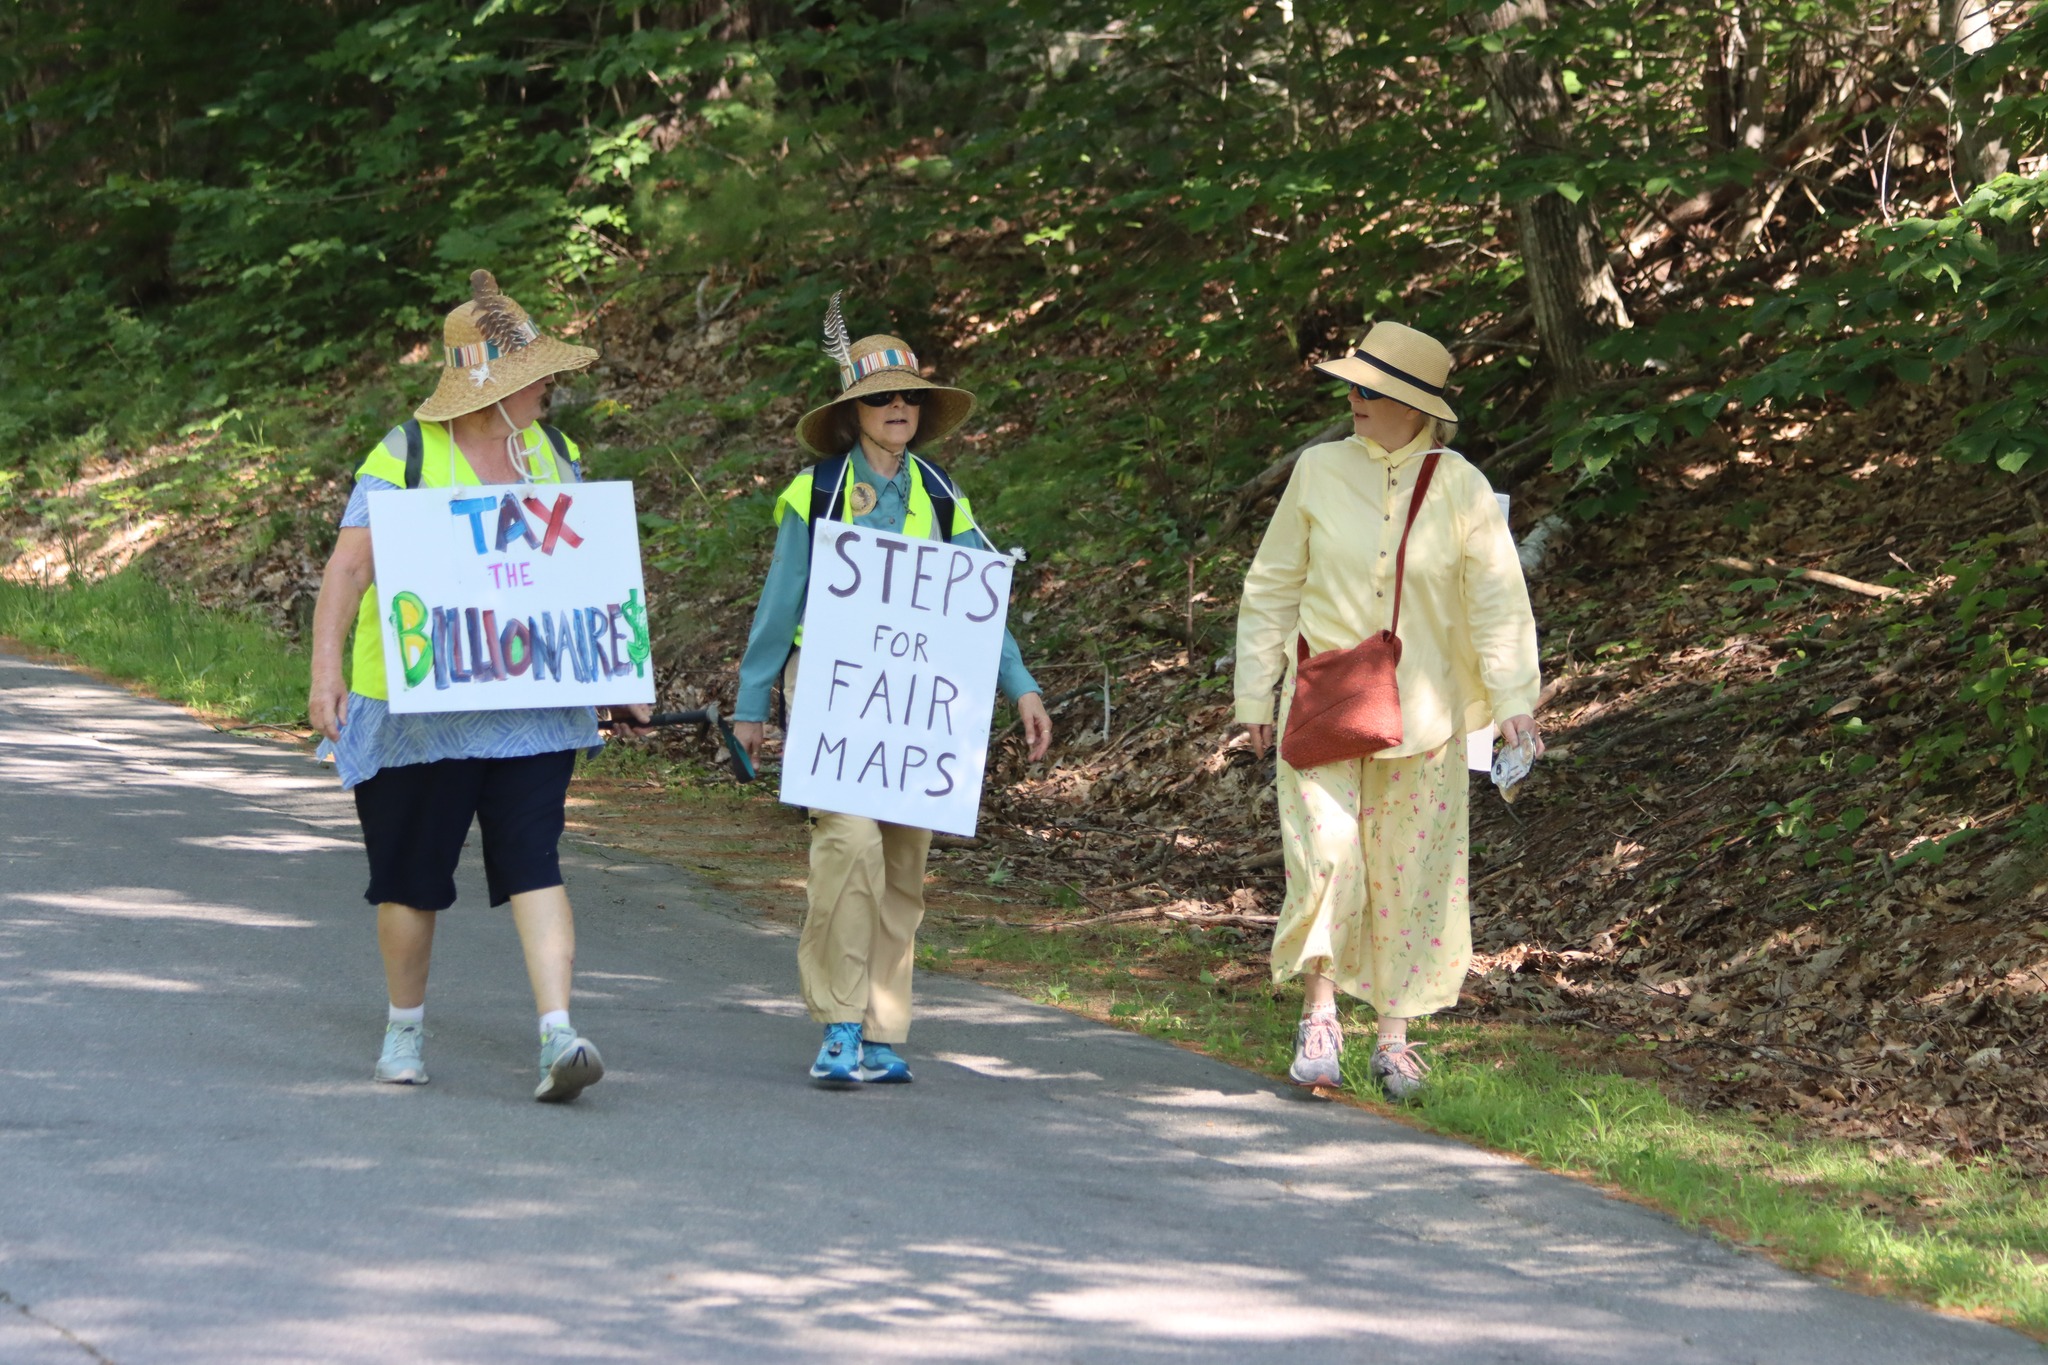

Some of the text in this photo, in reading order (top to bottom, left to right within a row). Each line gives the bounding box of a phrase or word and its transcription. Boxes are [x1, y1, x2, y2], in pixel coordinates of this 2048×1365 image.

[449, 490, 584, 556] TAX
[488, 561, 534, 589] THE
[828, 531, 1006, 622] STEPS
[873, 625, 929, 662] FOR
[828, 660, 959, 735] FAIR
[810, 732, 957, 797] MAPS
